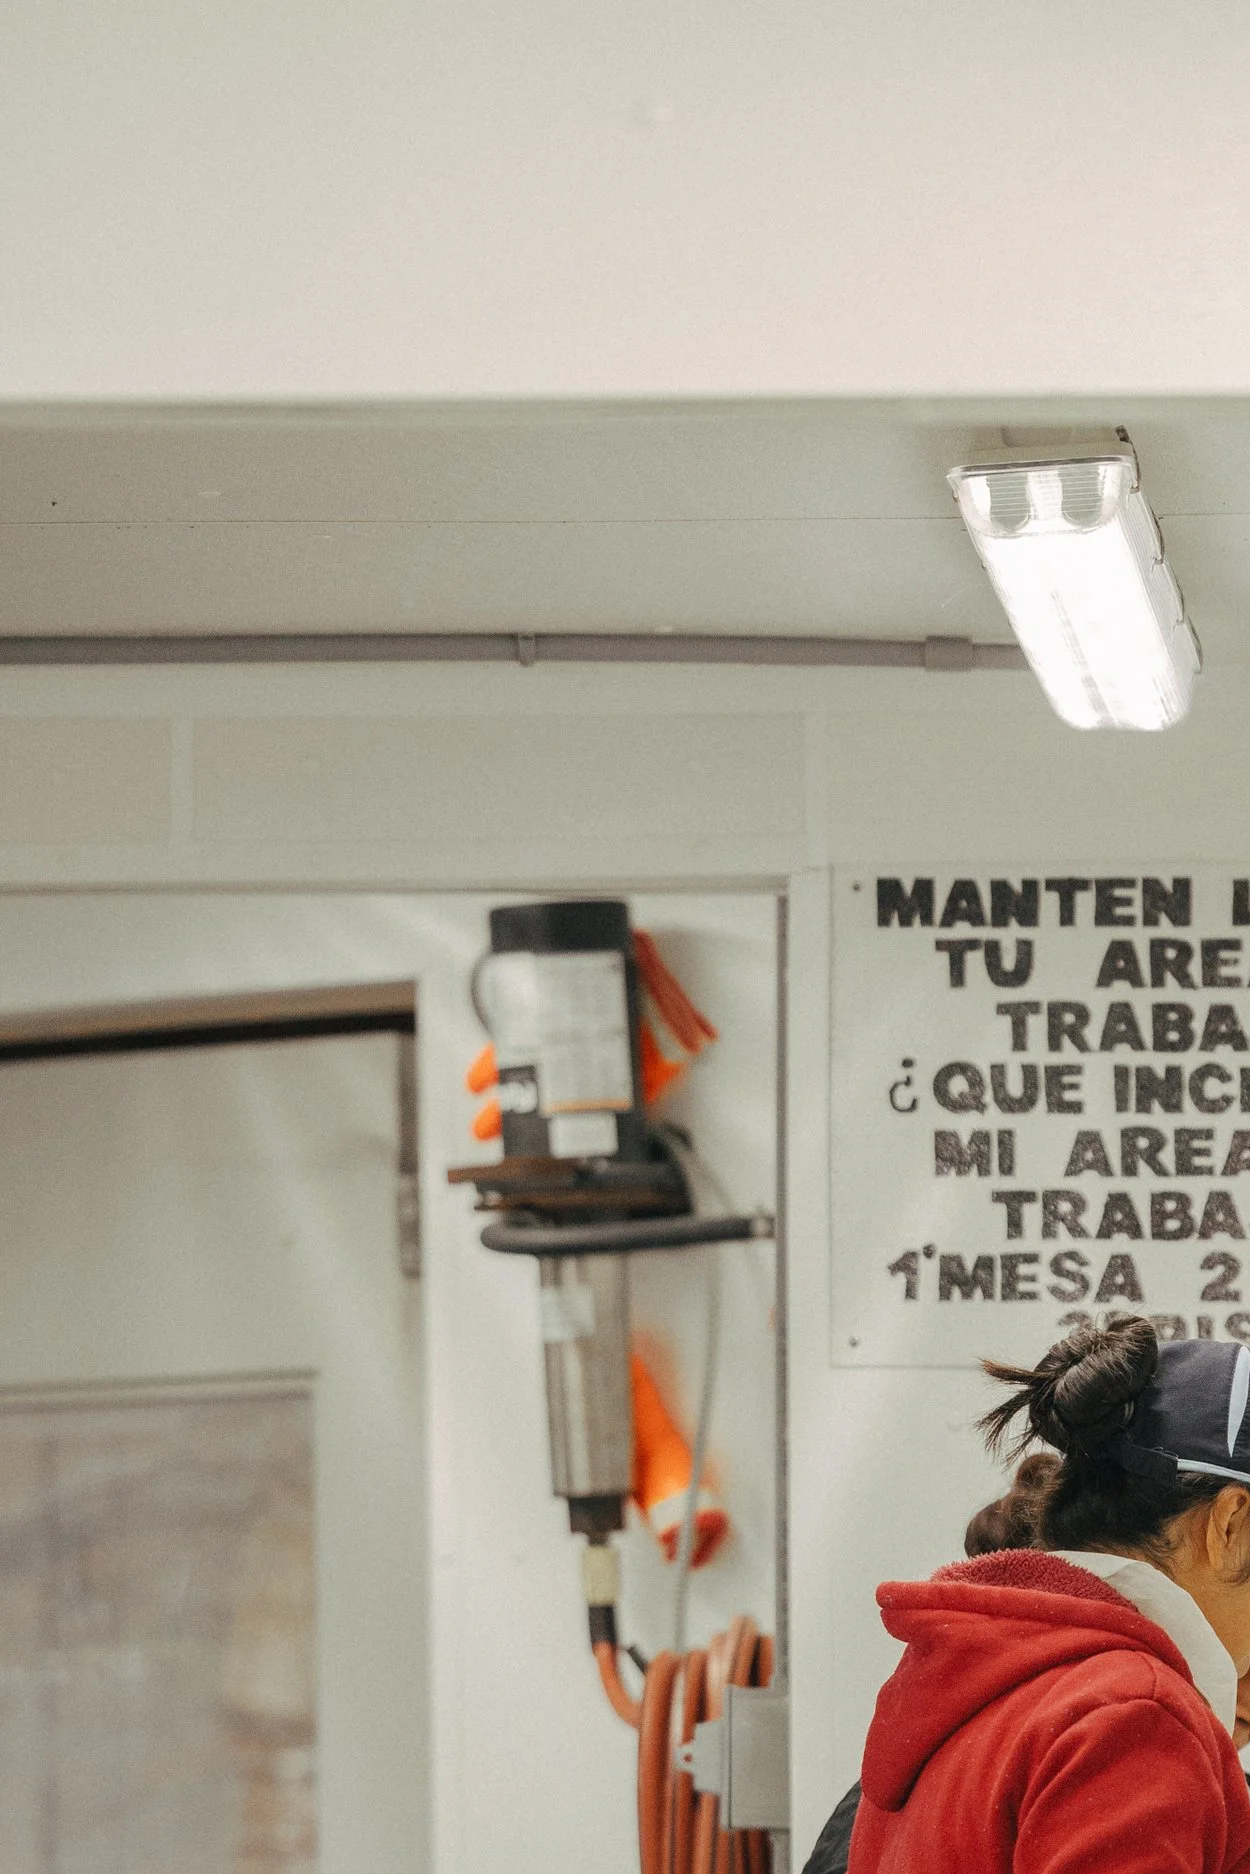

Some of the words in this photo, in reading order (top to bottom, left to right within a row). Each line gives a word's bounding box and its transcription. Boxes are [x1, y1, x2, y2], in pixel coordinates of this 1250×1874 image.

[876, 876, 1192, 929] MANTEN
[934, 937, 1035, 989] TU
[888, 1057, 1084, 1115] ¿QUE
[934, 1128, 1016, 1178] MI
